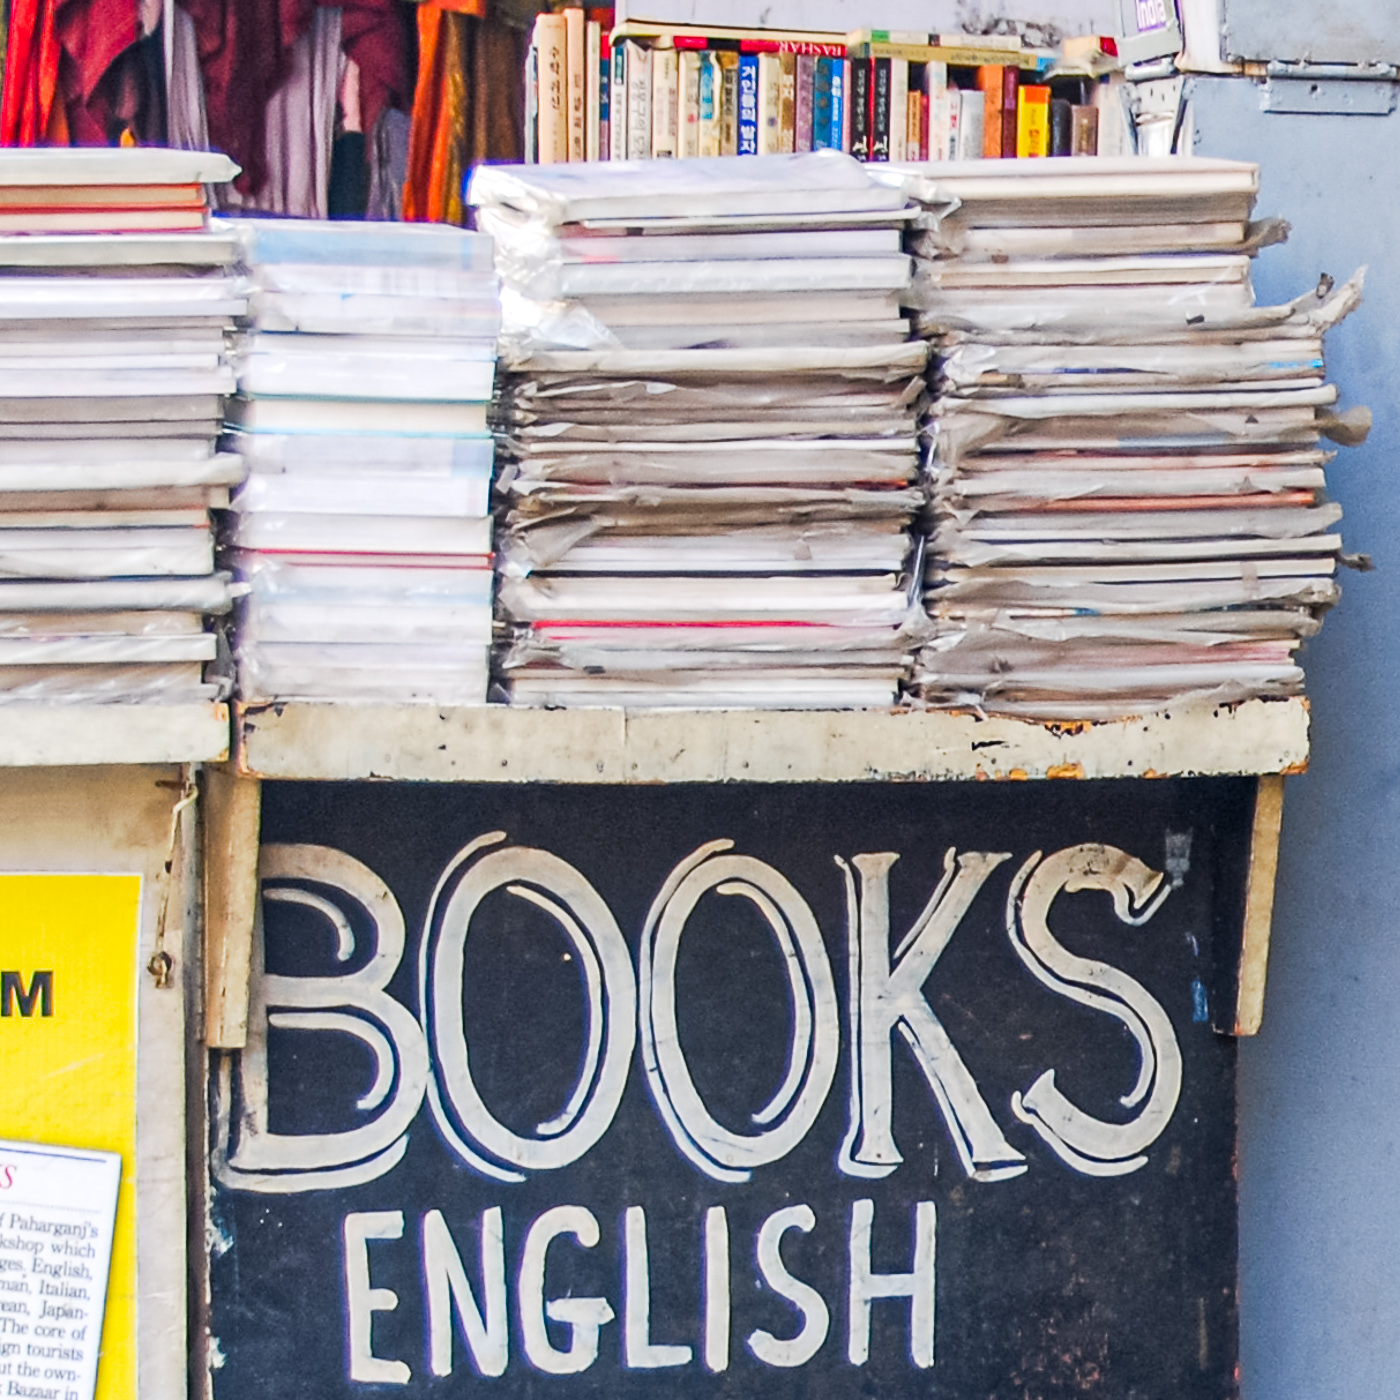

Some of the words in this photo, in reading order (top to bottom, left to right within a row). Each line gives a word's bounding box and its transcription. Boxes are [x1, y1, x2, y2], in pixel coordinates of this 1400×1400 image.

[212, 831, 1186, 1193] BOOKS
[9, 1212, 99, 1240] Paharganj's
[51, 1240, 96, 1258] which
[32, 1257, 93, 1281] English,
[39, 1279, 91, 1301] Italian,
[344, 1198, 937, 1384] ENGLISH
[38, 1299, 88, 1321] Japan-
[0, 1317, 29, 1335] The
[34, 1324, 66, 1339] core
[71, 1324, 88, 1341] of
[26, 1342, 84, 1361] tourists
[17, 1361, 40, 1377] the
[44, 1367, 81, 1382] own-
[7, 1380, 60, 1400] Bazaar
